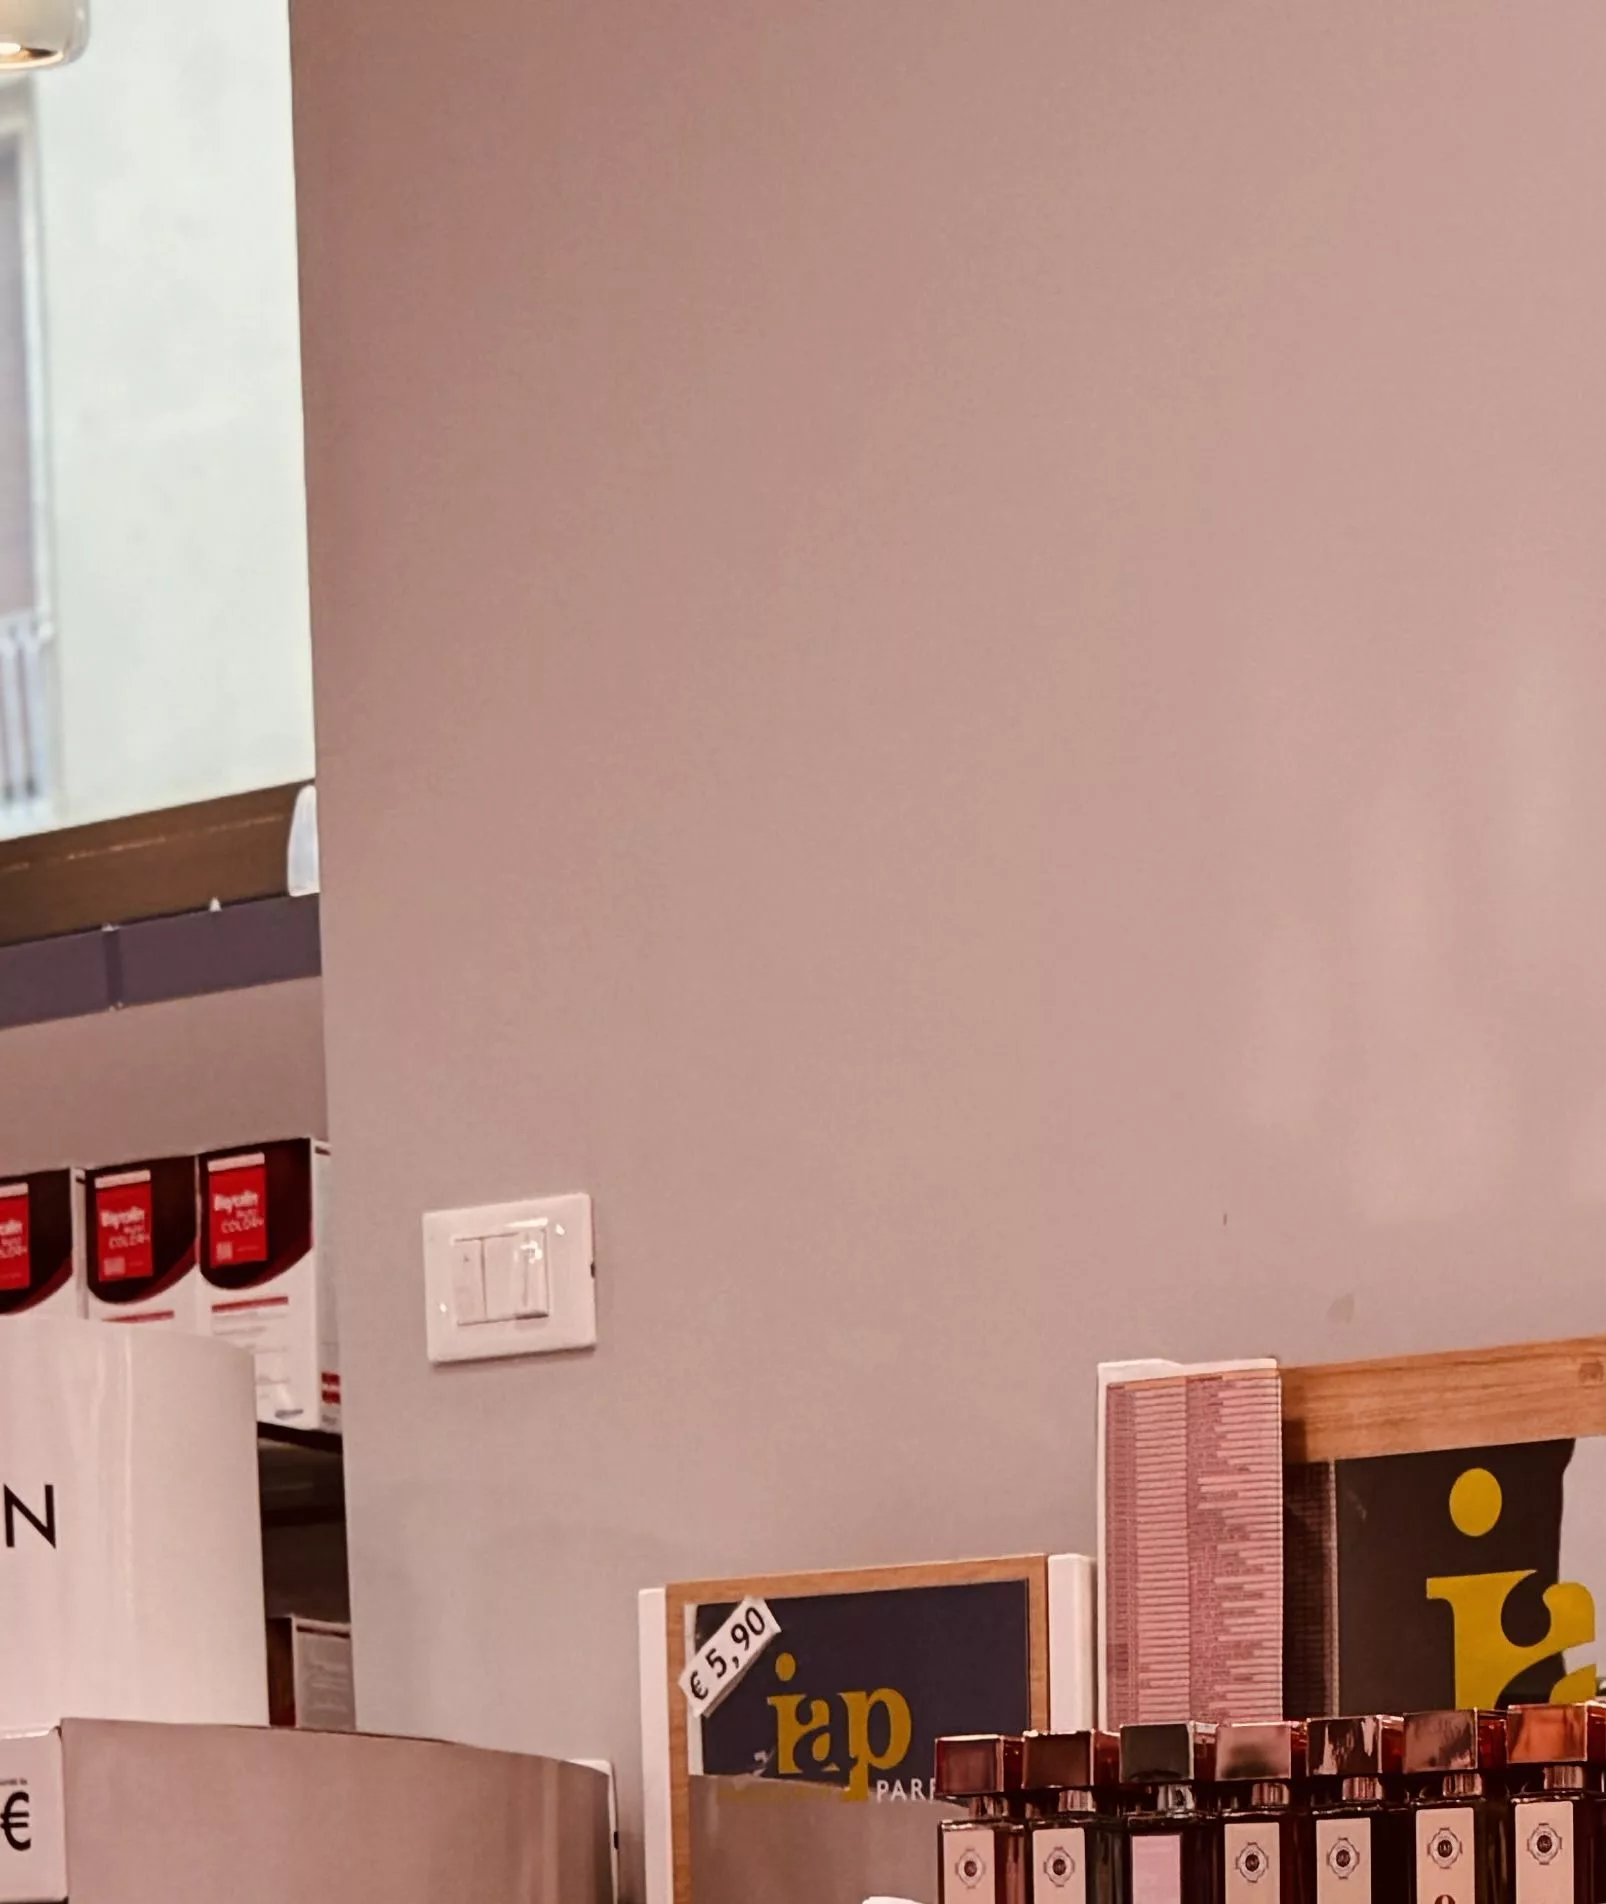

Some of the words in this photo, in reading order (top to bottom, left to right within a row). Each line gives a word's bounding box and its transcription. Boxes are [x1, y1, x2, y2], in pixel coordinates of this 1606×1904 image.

[690, 1669, 710, 1701] €
[705, 1604, 768, 1680] 5,90
[767, 1652, 913, 1802] iap
